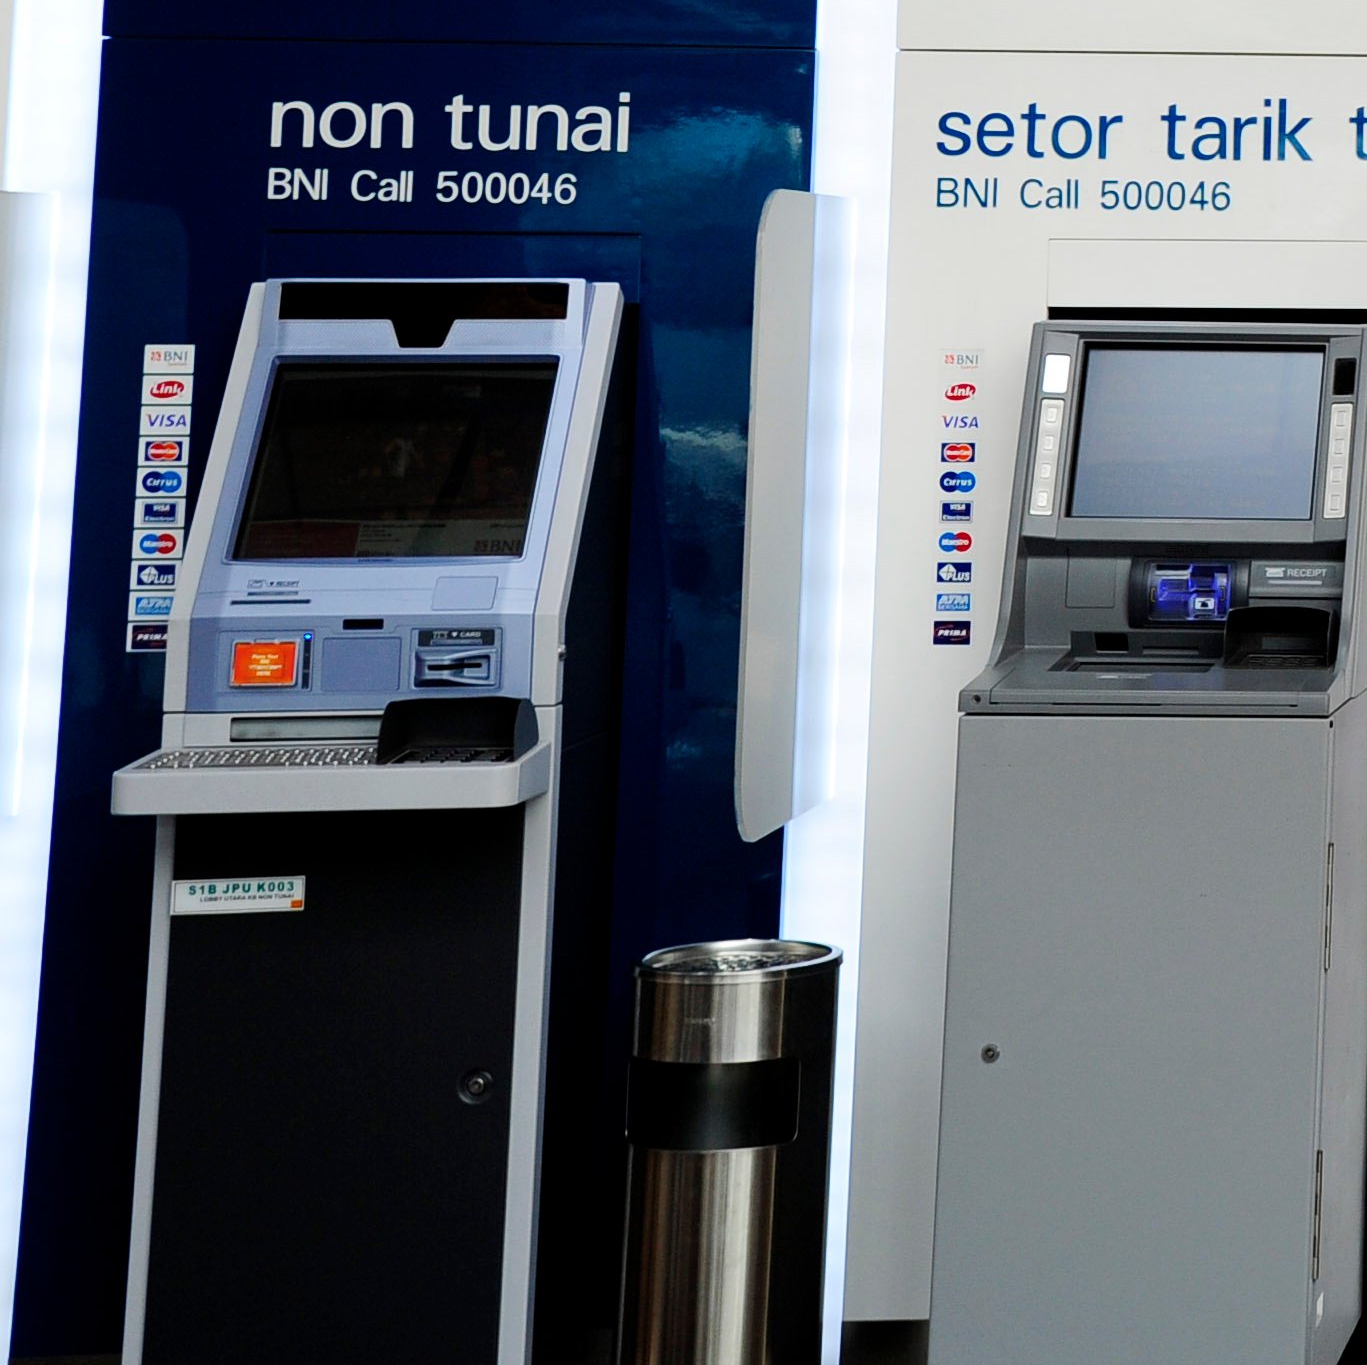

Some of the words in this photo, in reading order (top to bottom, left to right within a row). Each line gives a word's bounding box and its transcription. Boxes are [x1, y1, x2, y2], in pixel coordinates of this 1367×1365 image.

[269, 97, 414, 149] non
[444, 92, 631, 153] tunai
[936, 101, 1123, 159] setor
[1160, 99, 1313, 162] tarik
[266, 168, 328, 201] BNI
[350, 170, 413, 203] Call
[436, 171, 577, 205] 500046
[936, 177, 998, 209] BNI
[1019, 178, 1079, 209] Call
[1100, 180, 1232, 211] 500046
[164, 351, 187, 361] BNI
[957, 355, 978, 365] BNI
[147, 414, 186, 427] VISA
[942, 416, 979, 428] VISA
[1287, 568, 1327, 577] RECEIPT
[189, 885, 216, 895] S1B
[223, 883, 251, 894] JPU
[257, 881, 294, 893] K003
